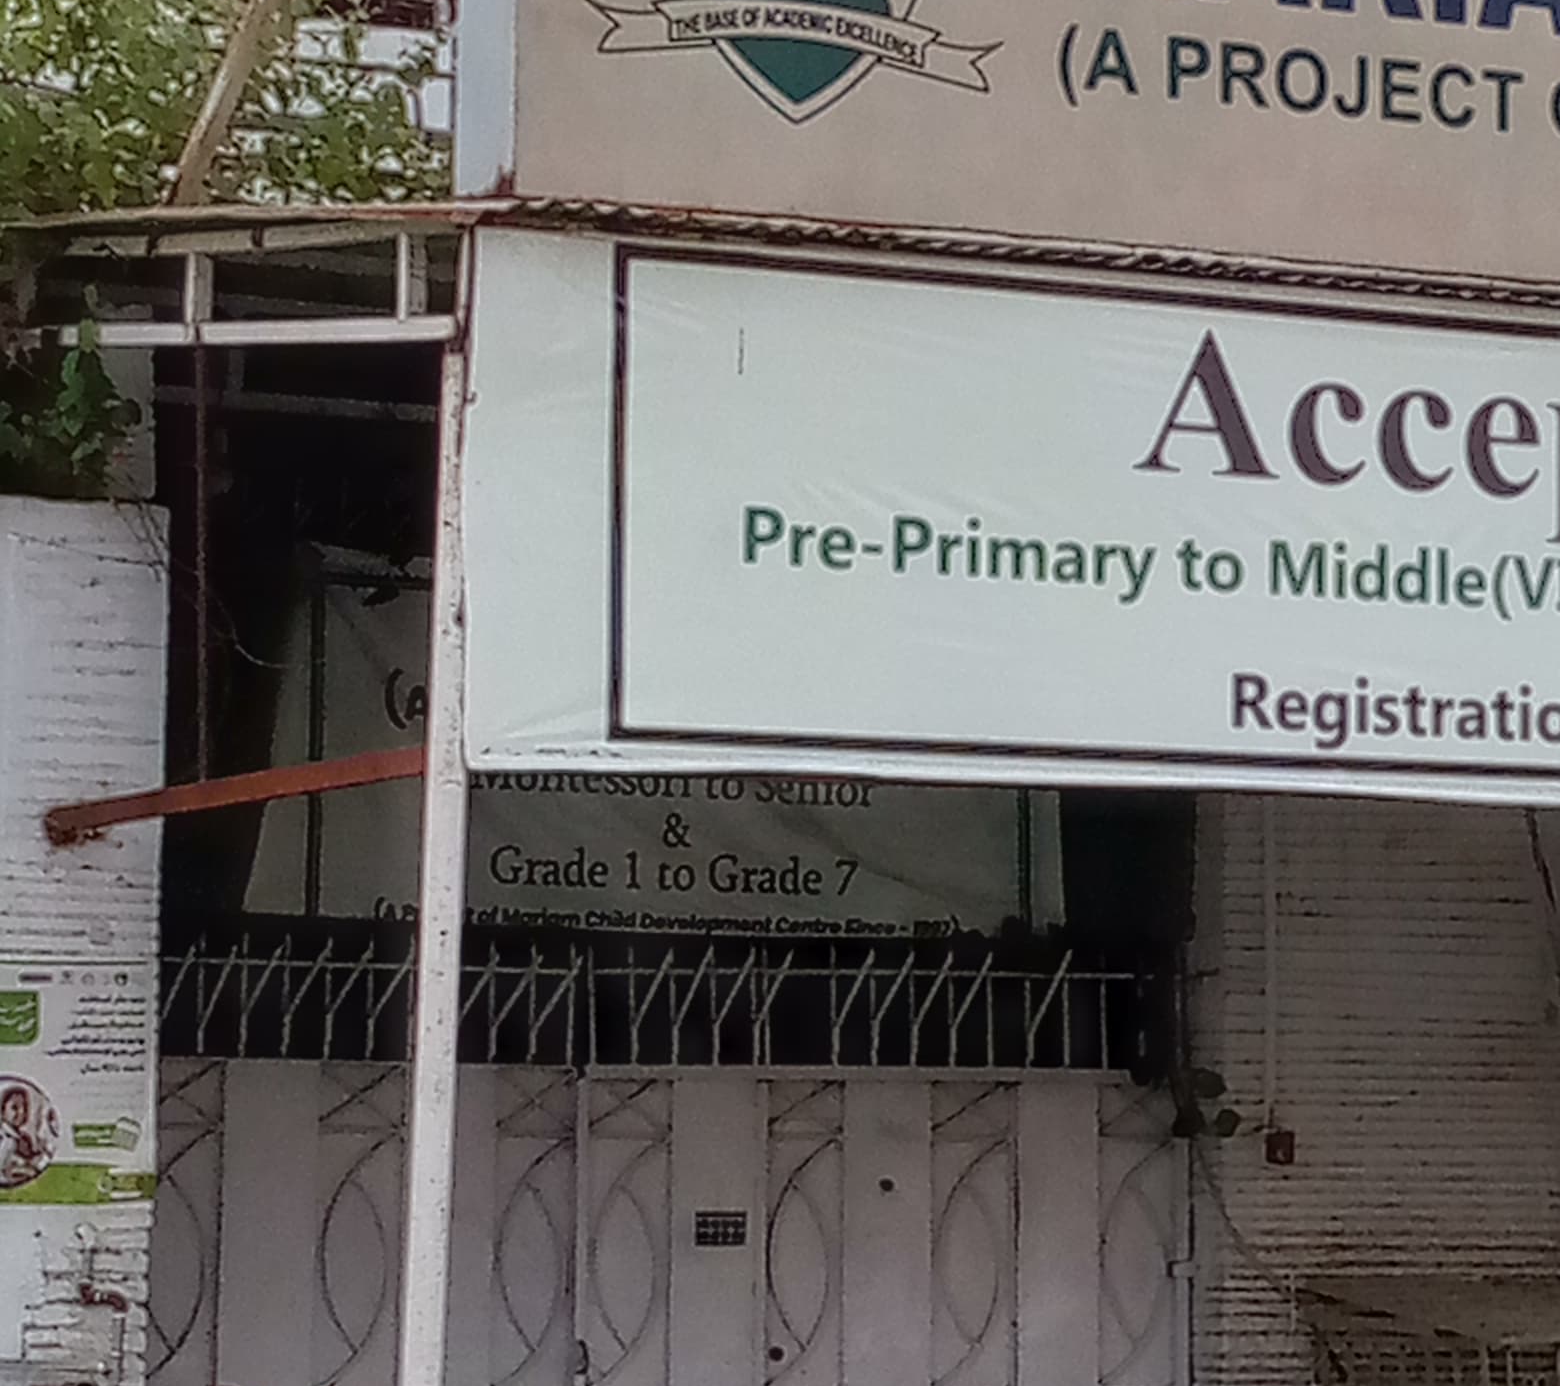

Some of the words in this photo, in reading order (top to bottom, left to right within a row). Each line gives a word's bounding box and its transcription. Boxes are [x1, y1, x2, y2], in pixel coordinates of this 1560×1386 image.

[674, 13, 701, 37] THE
[704, 7, 742, 32] BASE
[1059, 24, 1138, 106] (A
[1167, 36, 1523, 132] PROJECT
[744, 506, 1155, 603] Pre-Primary
[1177, 540, 1242, 591] to
[661, 812, 692, 849] &
[490, 844, 609, 888] Grade
[624, 850, 641, 890] 1
[658, 862, 696, 892] to
[708, 853, 823, 896] Grade
[835, 859, 859, 897] 7
